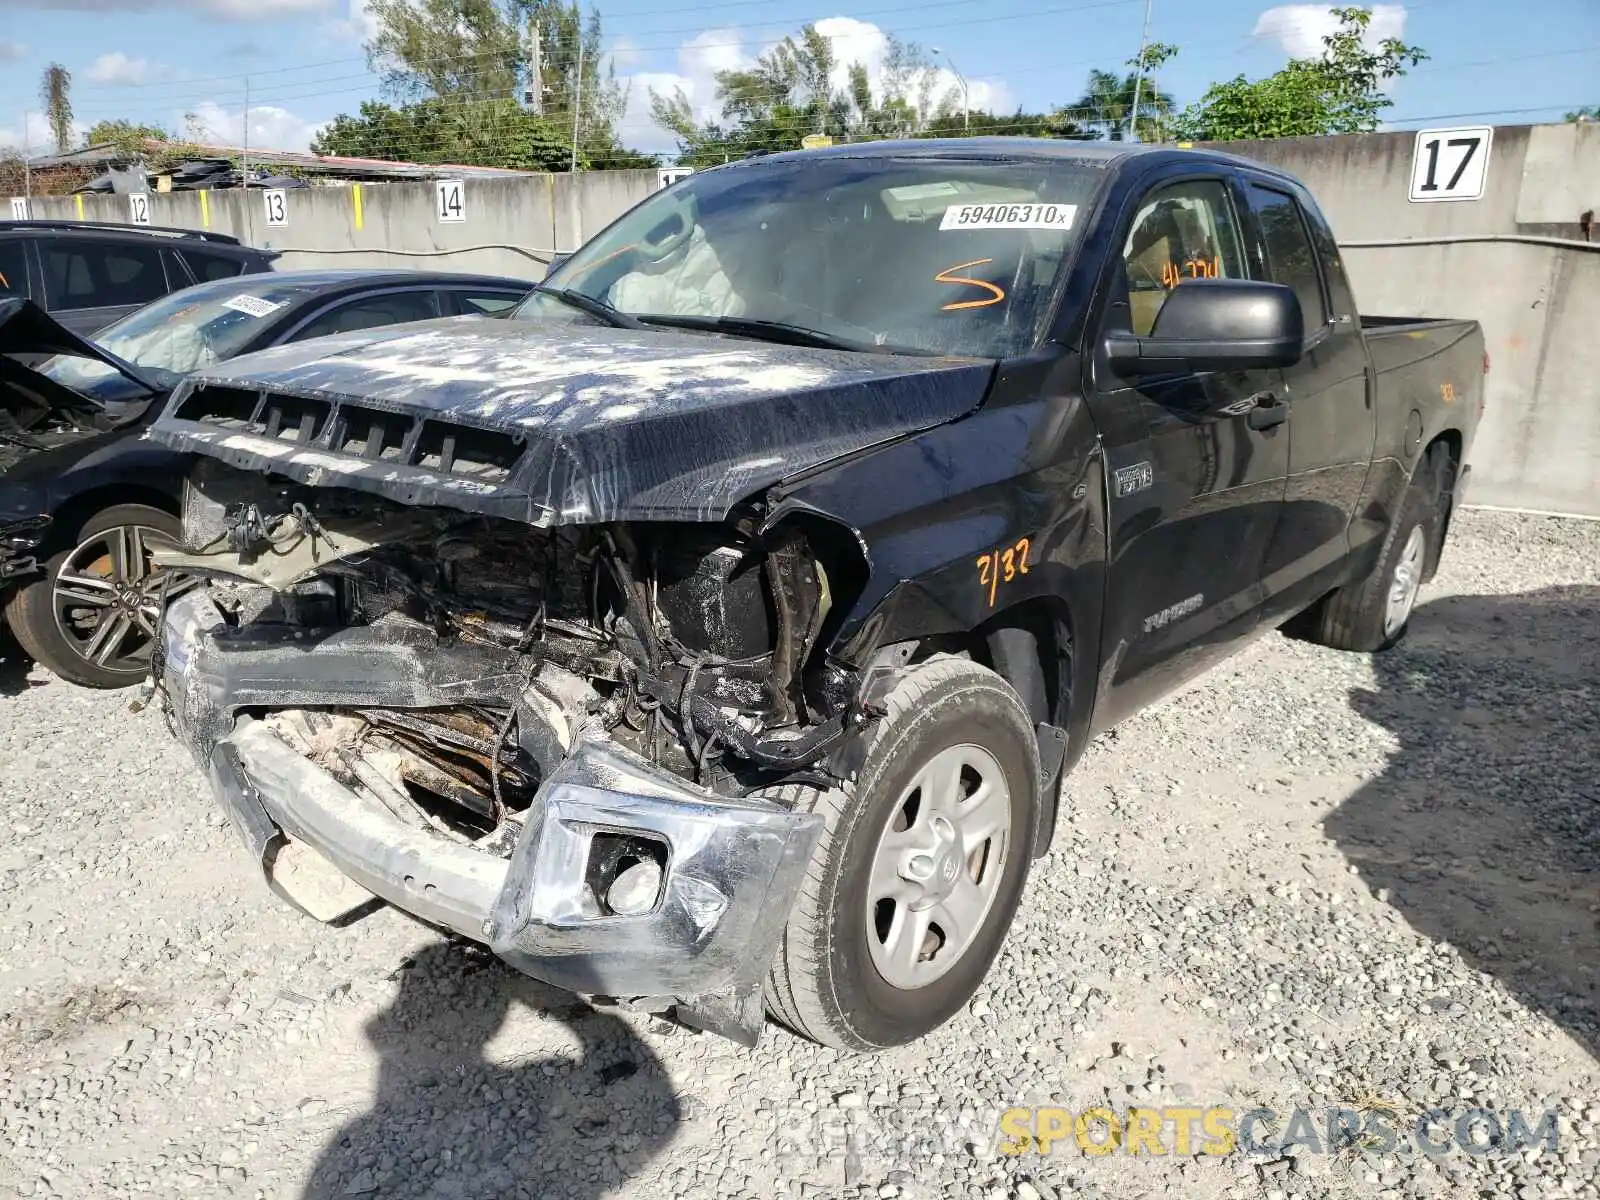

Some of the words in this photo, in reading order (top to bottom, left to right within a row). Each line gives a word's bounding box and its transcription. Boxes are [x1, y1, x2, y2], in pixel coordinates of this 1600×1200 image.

[1420, 137, 1481, 191] 17
[132, 197, 148, 222] 12
[267, 193, 285, 222] 13
[440, 182, 462, 217] 14
